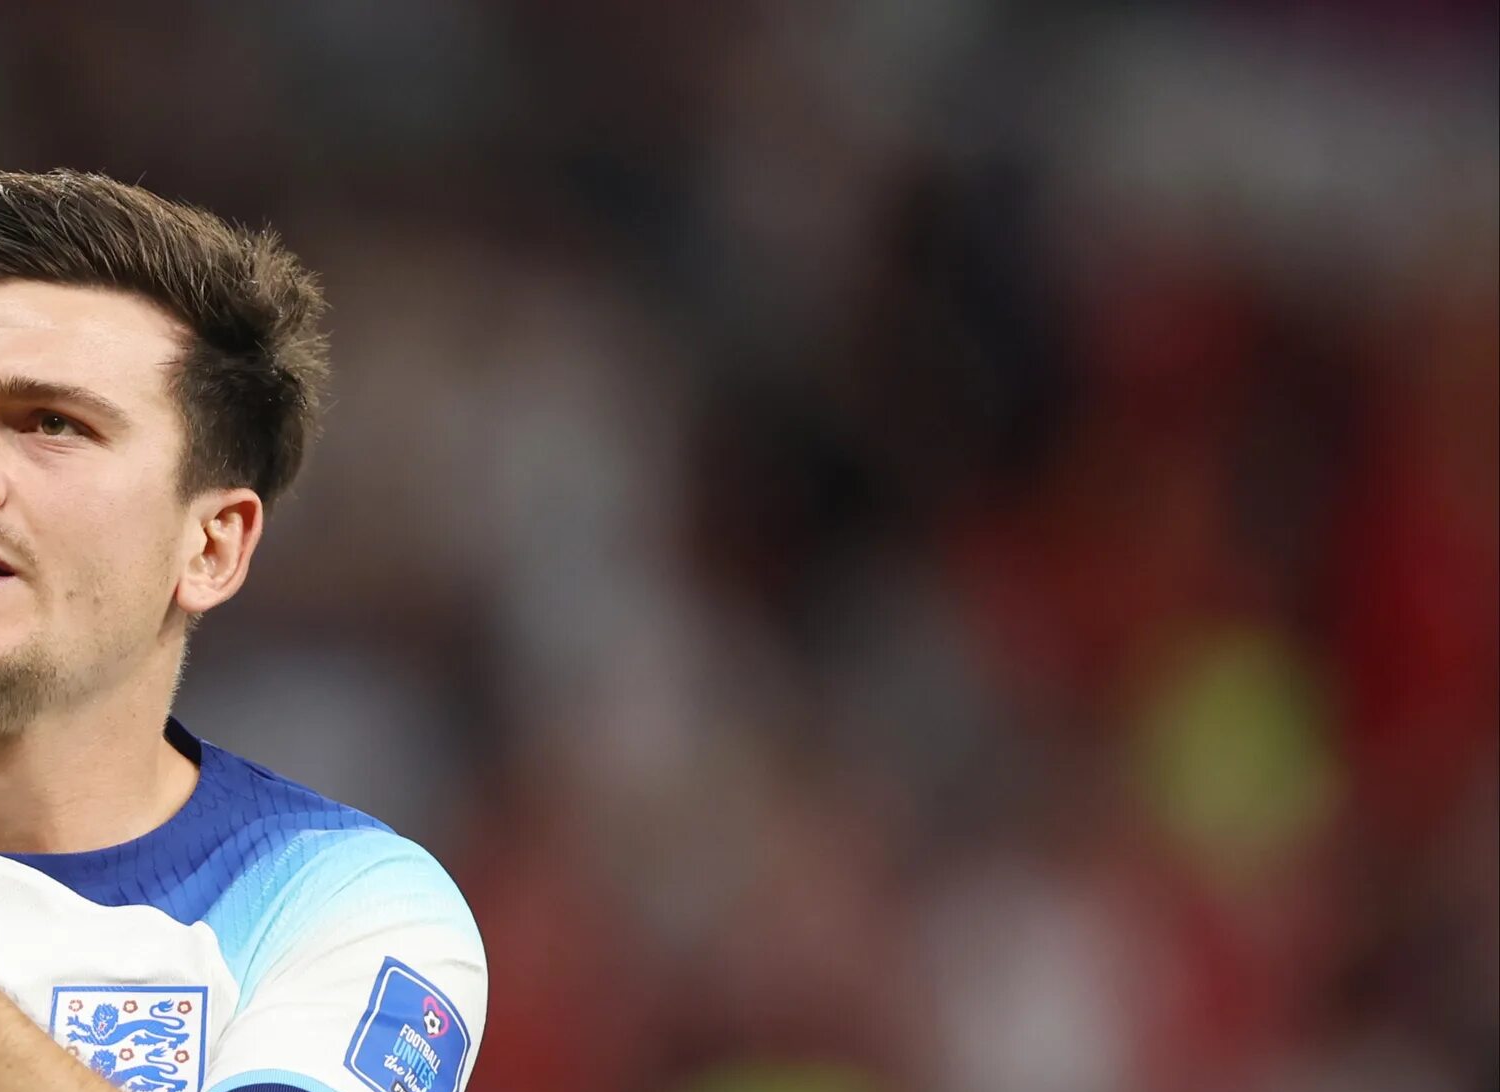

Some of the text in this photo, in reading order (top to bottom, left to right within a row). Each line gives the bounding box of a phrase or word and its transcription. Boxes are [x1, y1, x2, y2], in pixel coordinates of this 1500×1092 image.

[384, 1054, 405, 1076] the
[392, 1038, 435, 1089] UNITES
[400, 1024, 441, 1075] FOOTBALL
